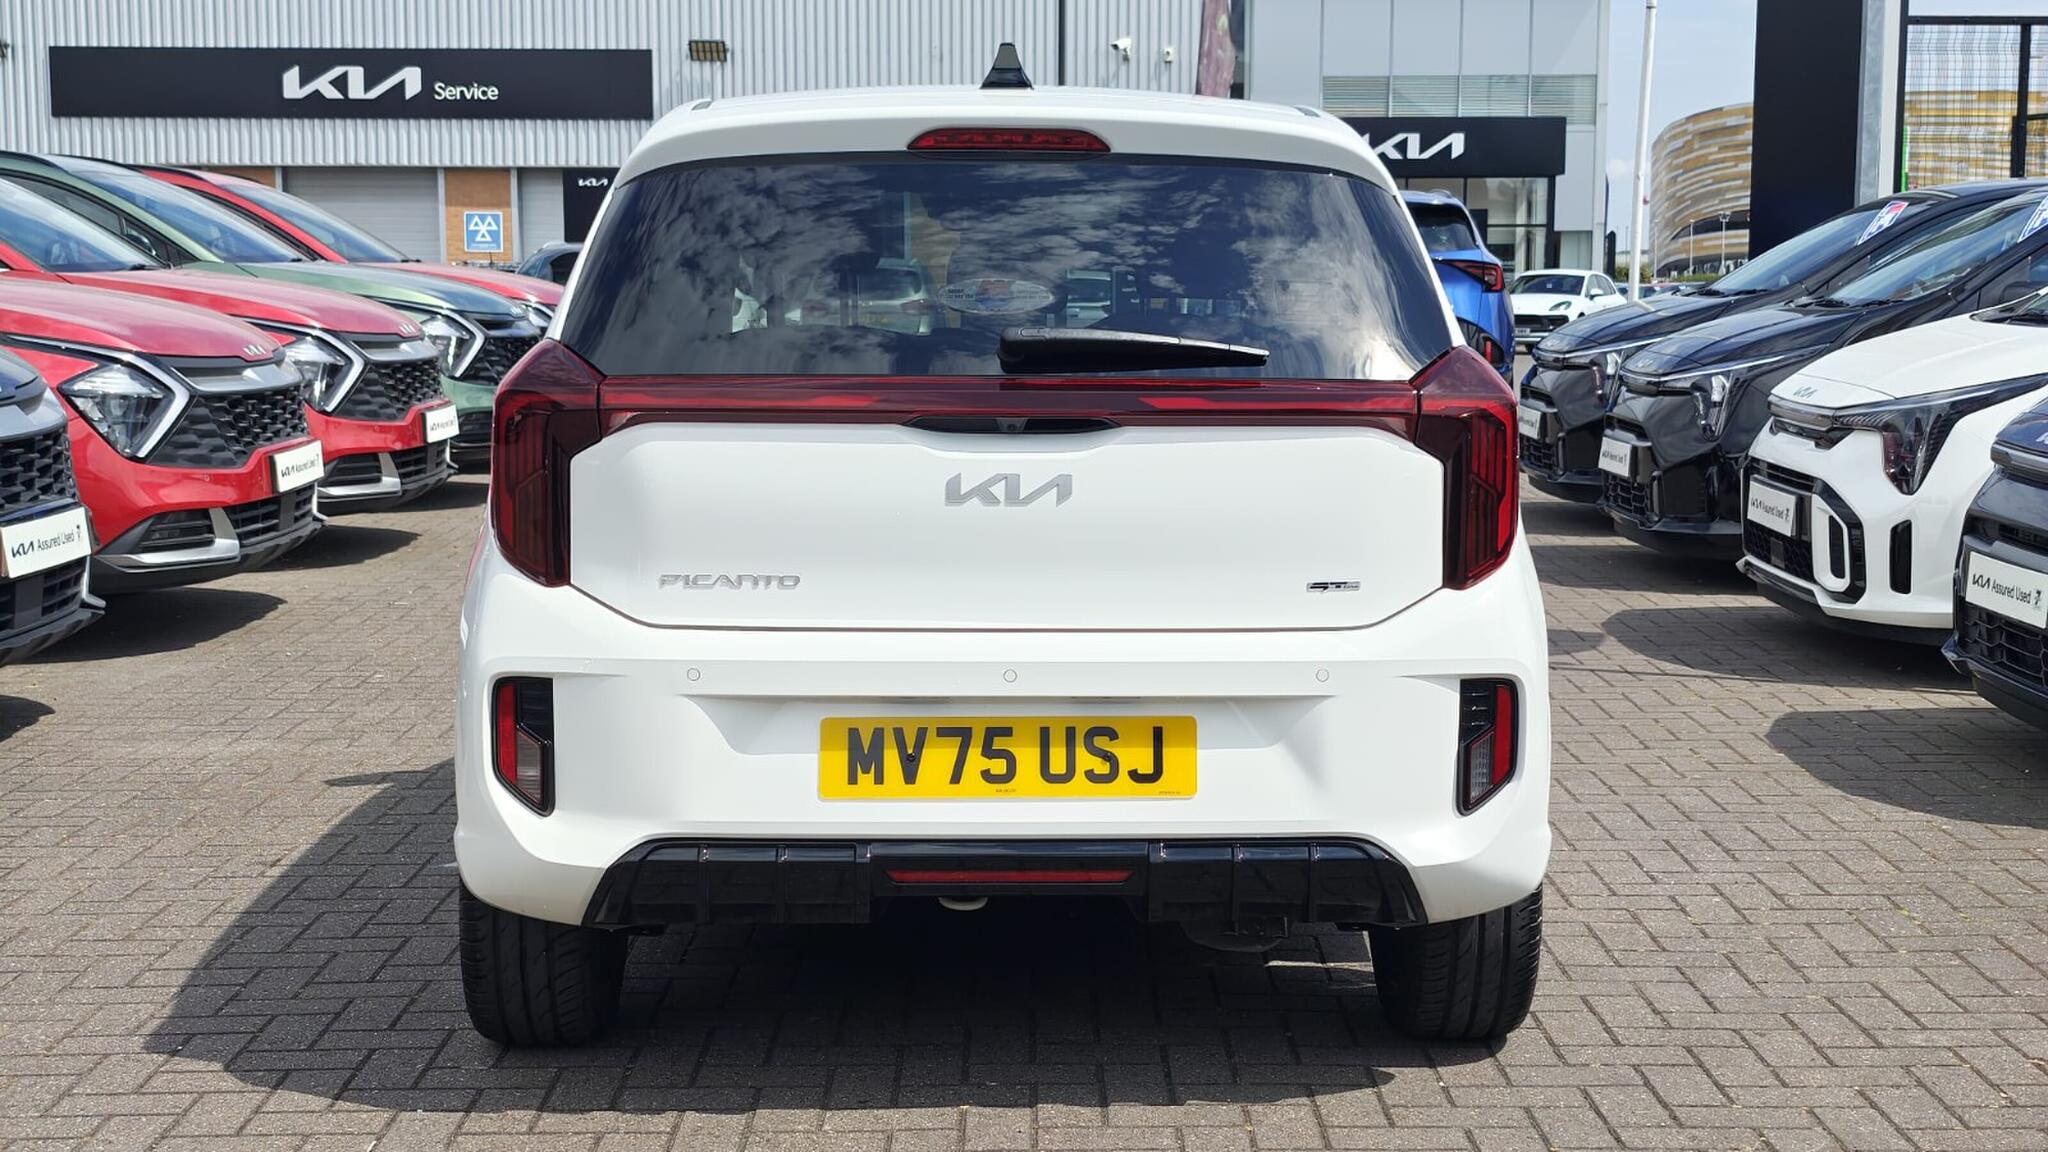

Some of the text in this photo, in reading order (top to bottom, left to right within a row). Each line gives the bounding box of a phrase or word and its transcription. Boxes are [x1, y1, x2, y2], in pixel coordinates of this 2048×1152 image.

[283, 65, 499, 100] KIA Service
[945, 472, 1072, 507] KIA
[11, 529, 75, 558] KIA Assured Used
[659, 574, 800, 590] PICANTO
[1972, 573, 2032, 604] KIA Assured Used
[848, 726, 1163, 785] MV75 USJ
